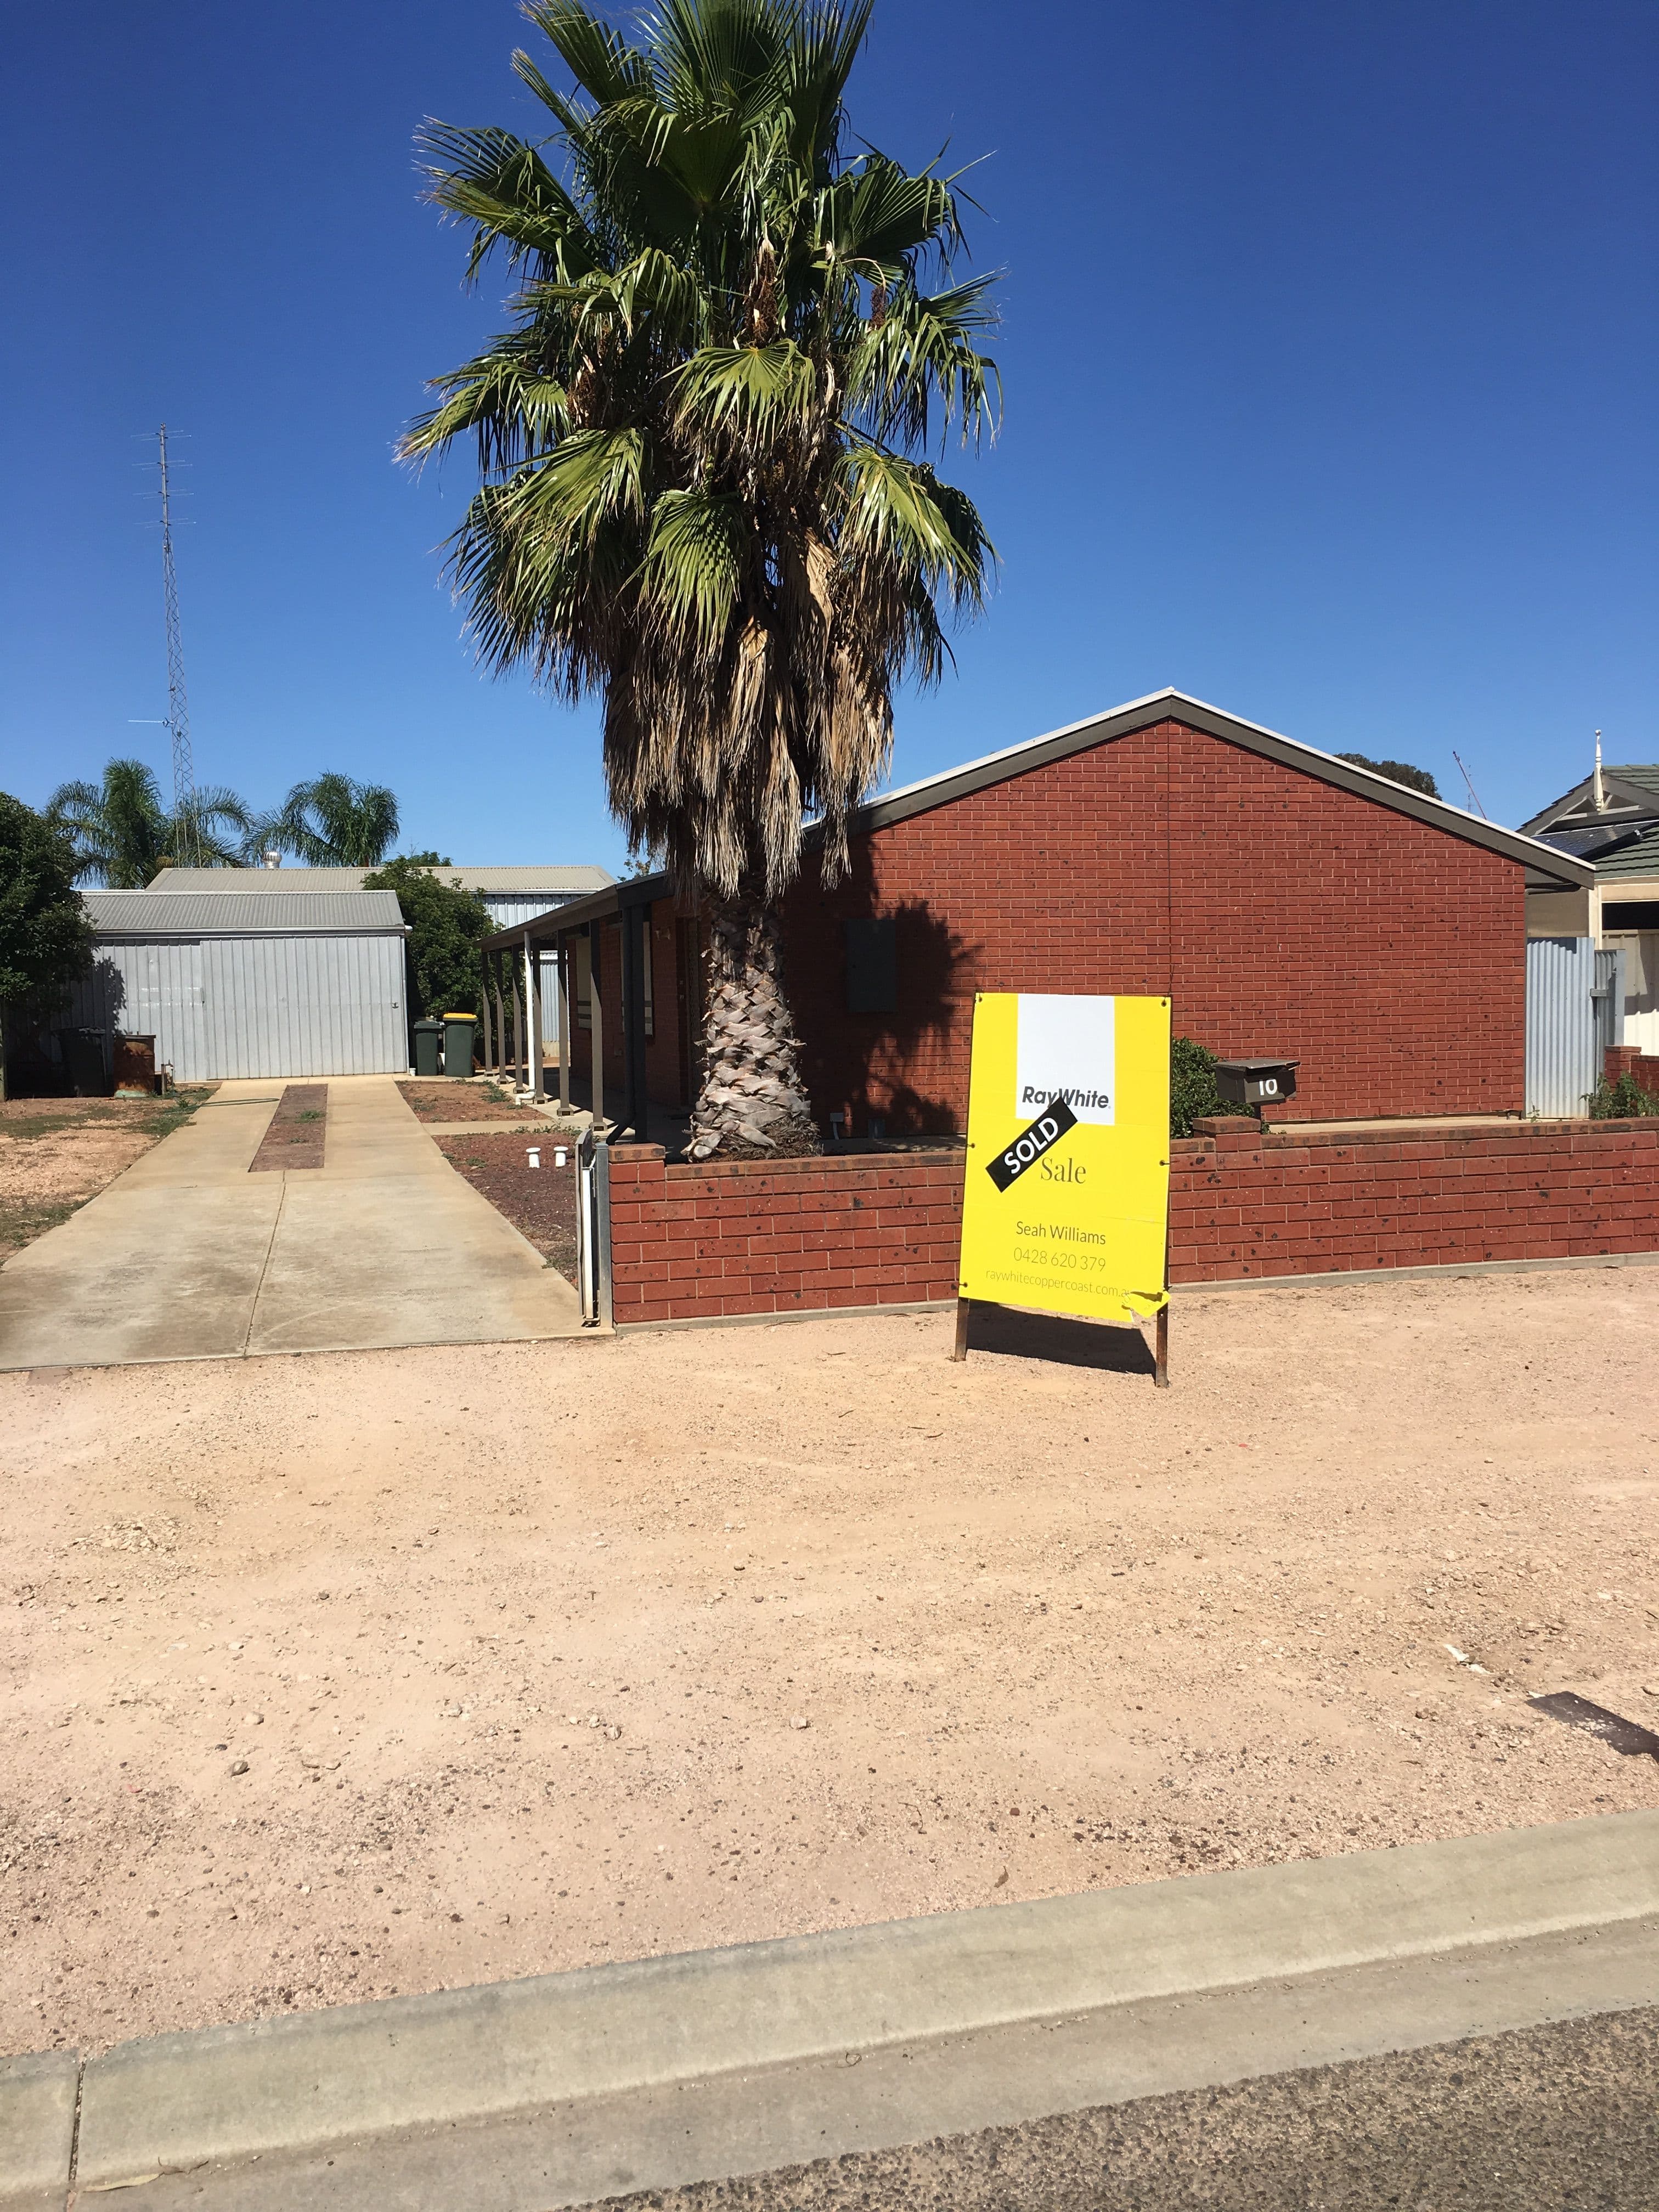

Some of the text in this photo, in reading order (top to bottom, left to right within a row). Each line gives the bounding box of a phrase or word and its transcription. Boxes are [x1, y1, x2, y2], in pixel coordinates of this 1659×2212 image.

[1259, 1079, 1278, 1096] 10
[1004, 1118, 1058, 1174] SOLD
[1041, 1157, 1086, 1184] Sale
[1016, 1221, 1106, 1245] Seah Williams
[1014, 1247, 1106, 1272] 0428 620 379
